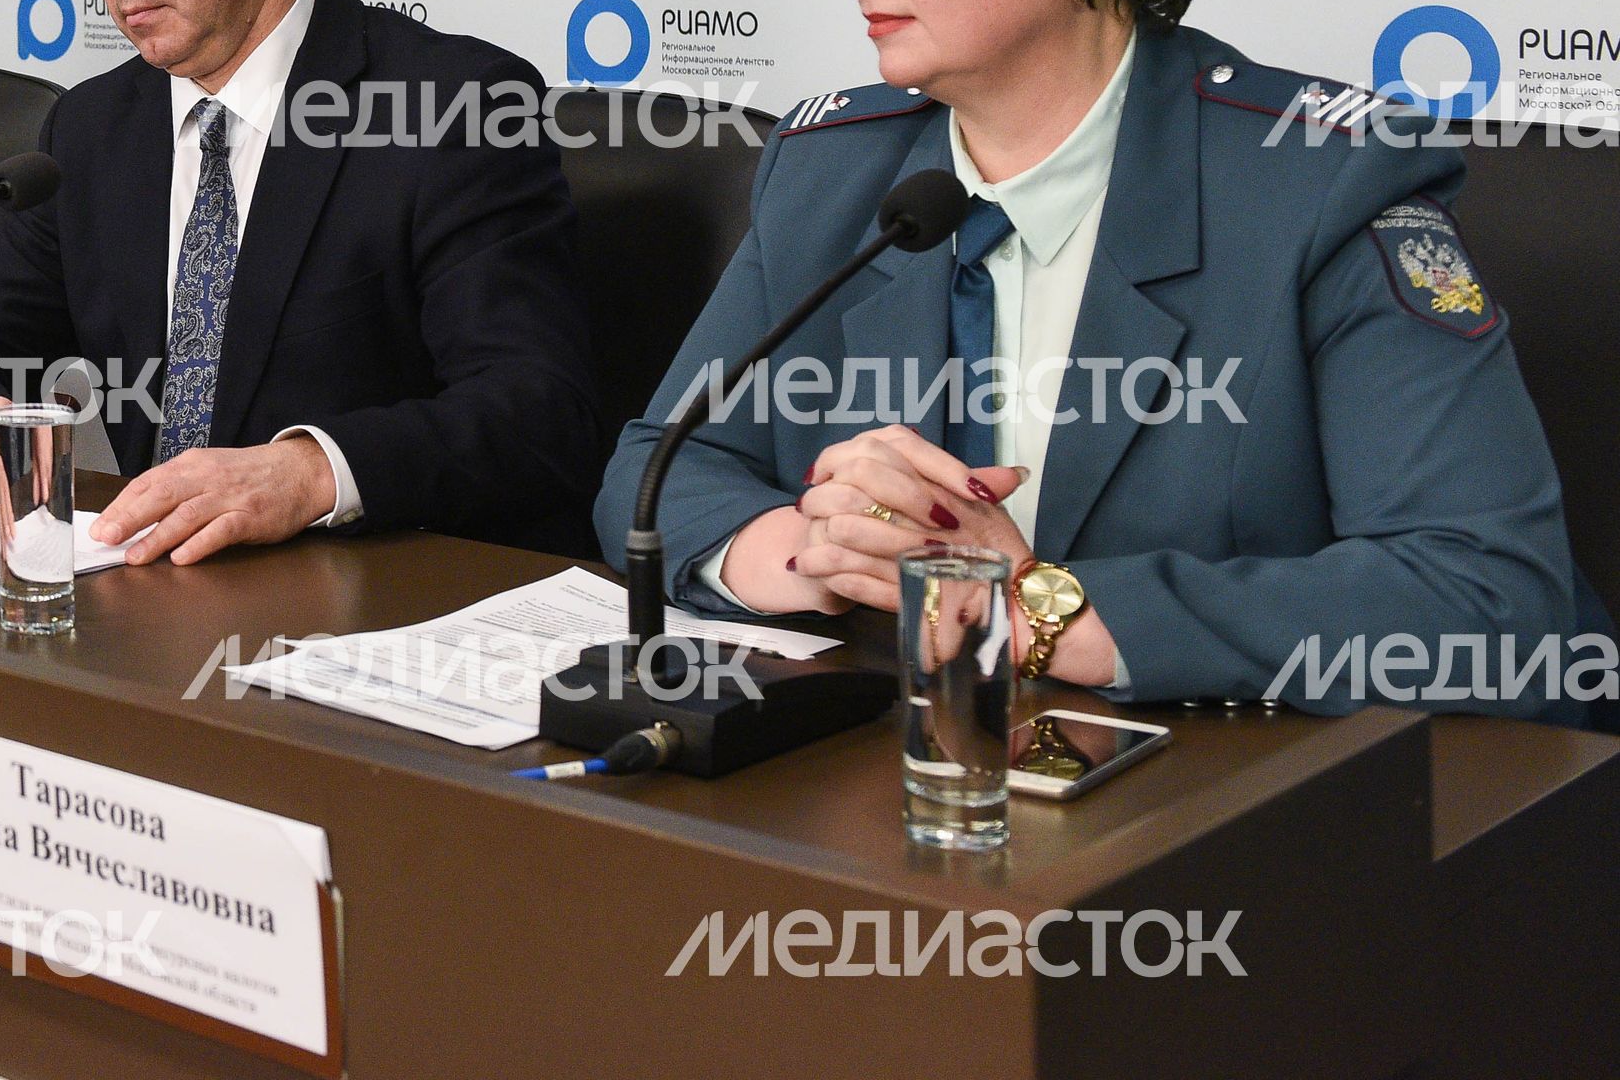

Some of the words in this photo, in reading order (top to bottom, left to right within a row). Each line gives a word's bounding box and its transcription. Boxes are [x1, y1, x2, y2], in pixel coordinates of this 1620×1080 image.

[661, 9, 759, 37] РИАМО
[661, 41, 716, 53] Региональное
[1519, 28, 1620, 62] РИАМ
[661, 54, 733, 66] Информационное
[735, 56, 776, 67] Агентство
[661, 65, 710, 77] Московской
[711, 67, 745, 78] Области
[1518, 68, 1603, 81] Региональное
[1518, 83, 1620, 98] Информационно
[1518, 98, 1592, 111] Московской
[10, 760, 167, 842] Тарасова
[30, 824, 277, 936] Вячеславовна
